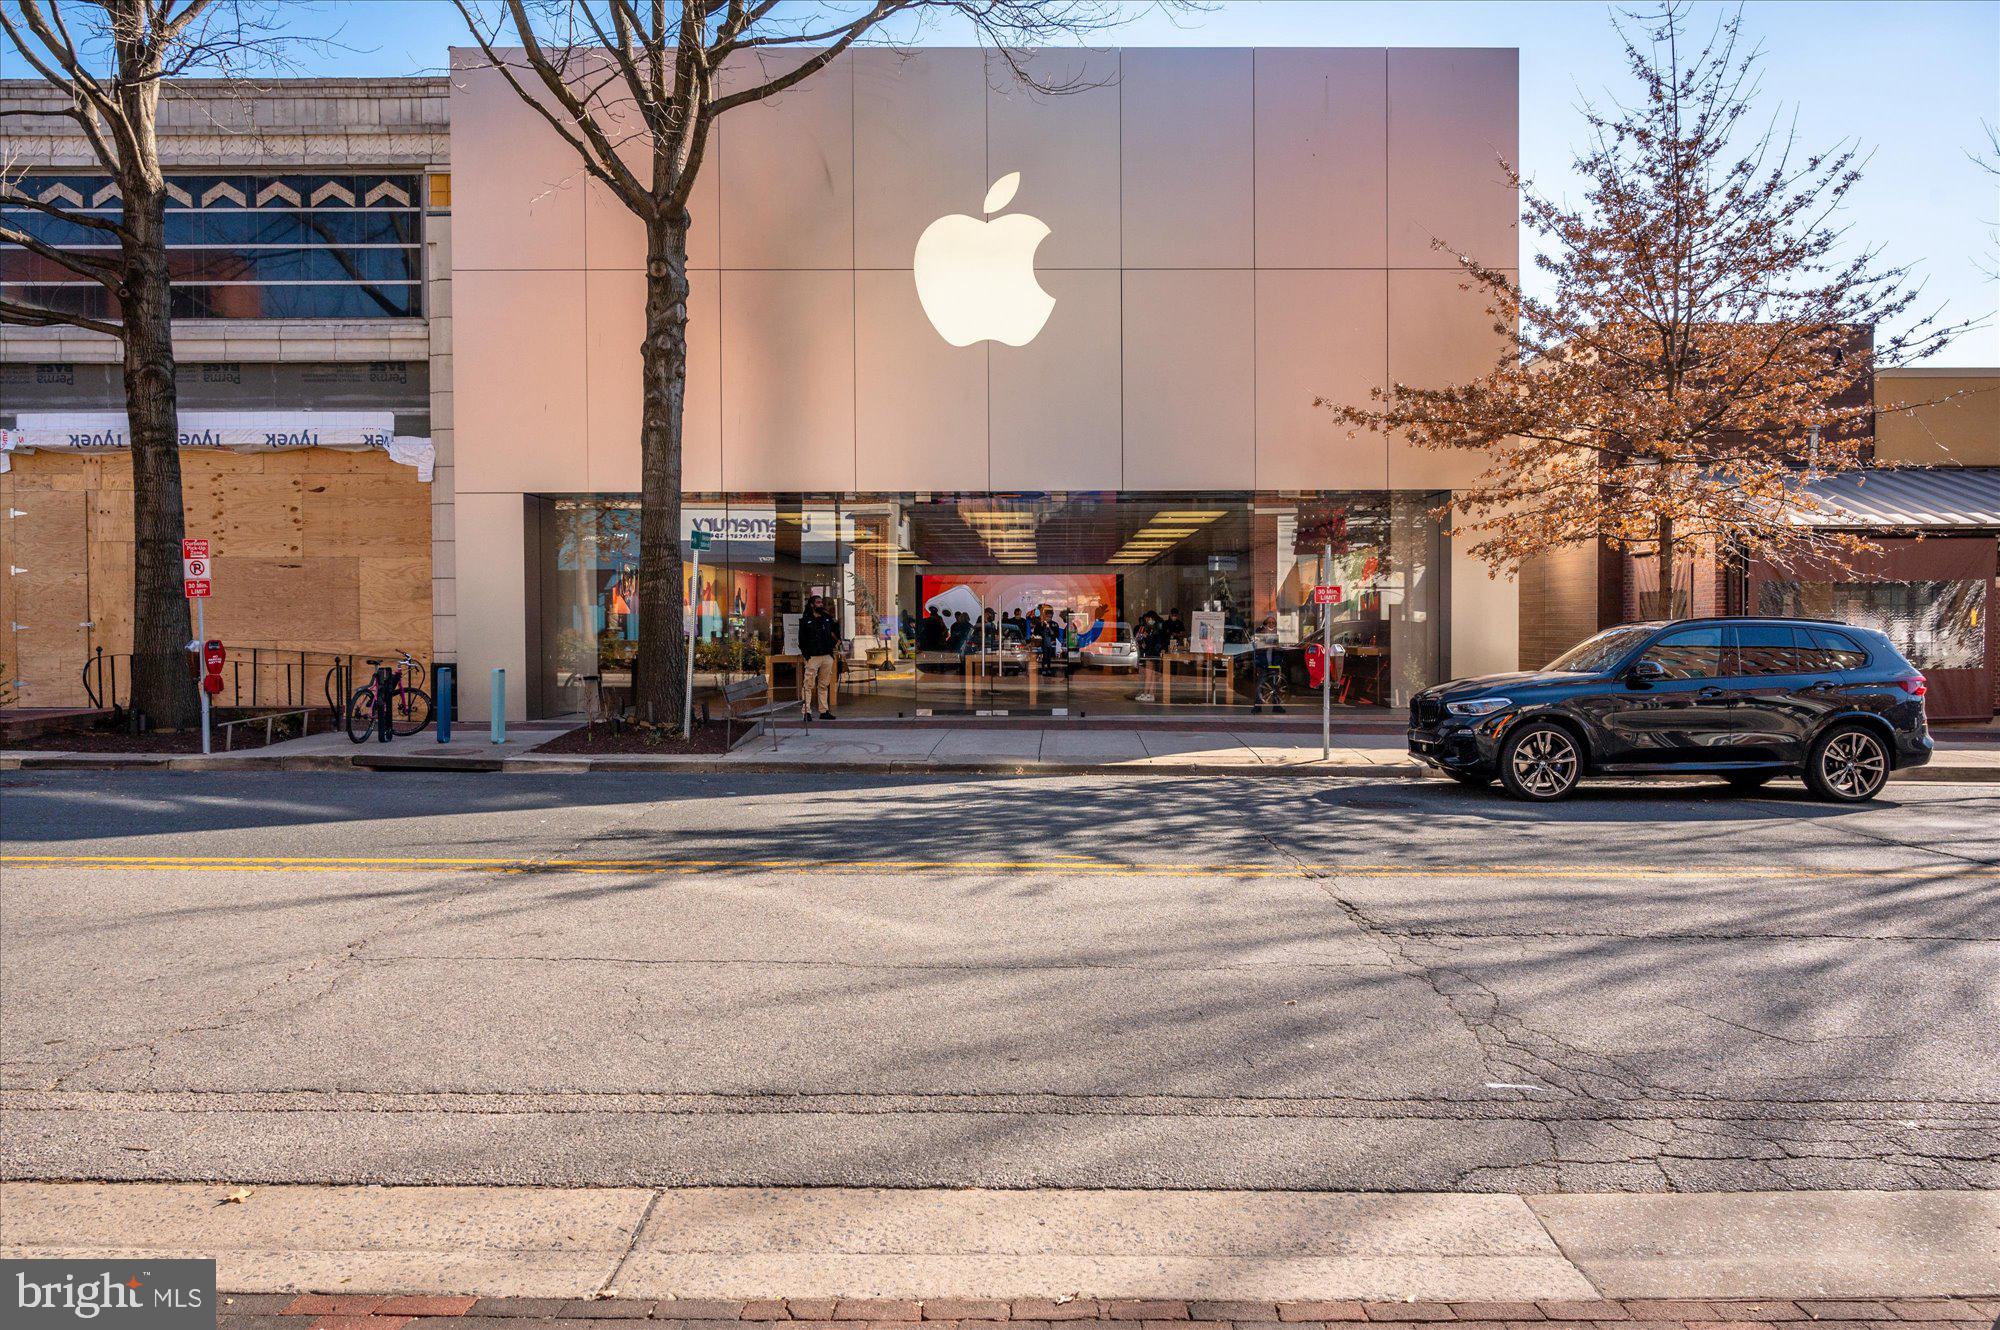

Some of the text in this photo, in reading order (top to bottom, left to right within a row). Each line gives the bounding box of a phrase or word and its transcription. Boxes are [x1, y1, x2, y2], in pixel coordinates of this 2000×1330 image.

[37, 374, 74, 385] Perma
[69, 429, 127, 449] Tyvek
[179, 429, 222, 447] Tyve
[265, 429, 319, 448] Tyvek
